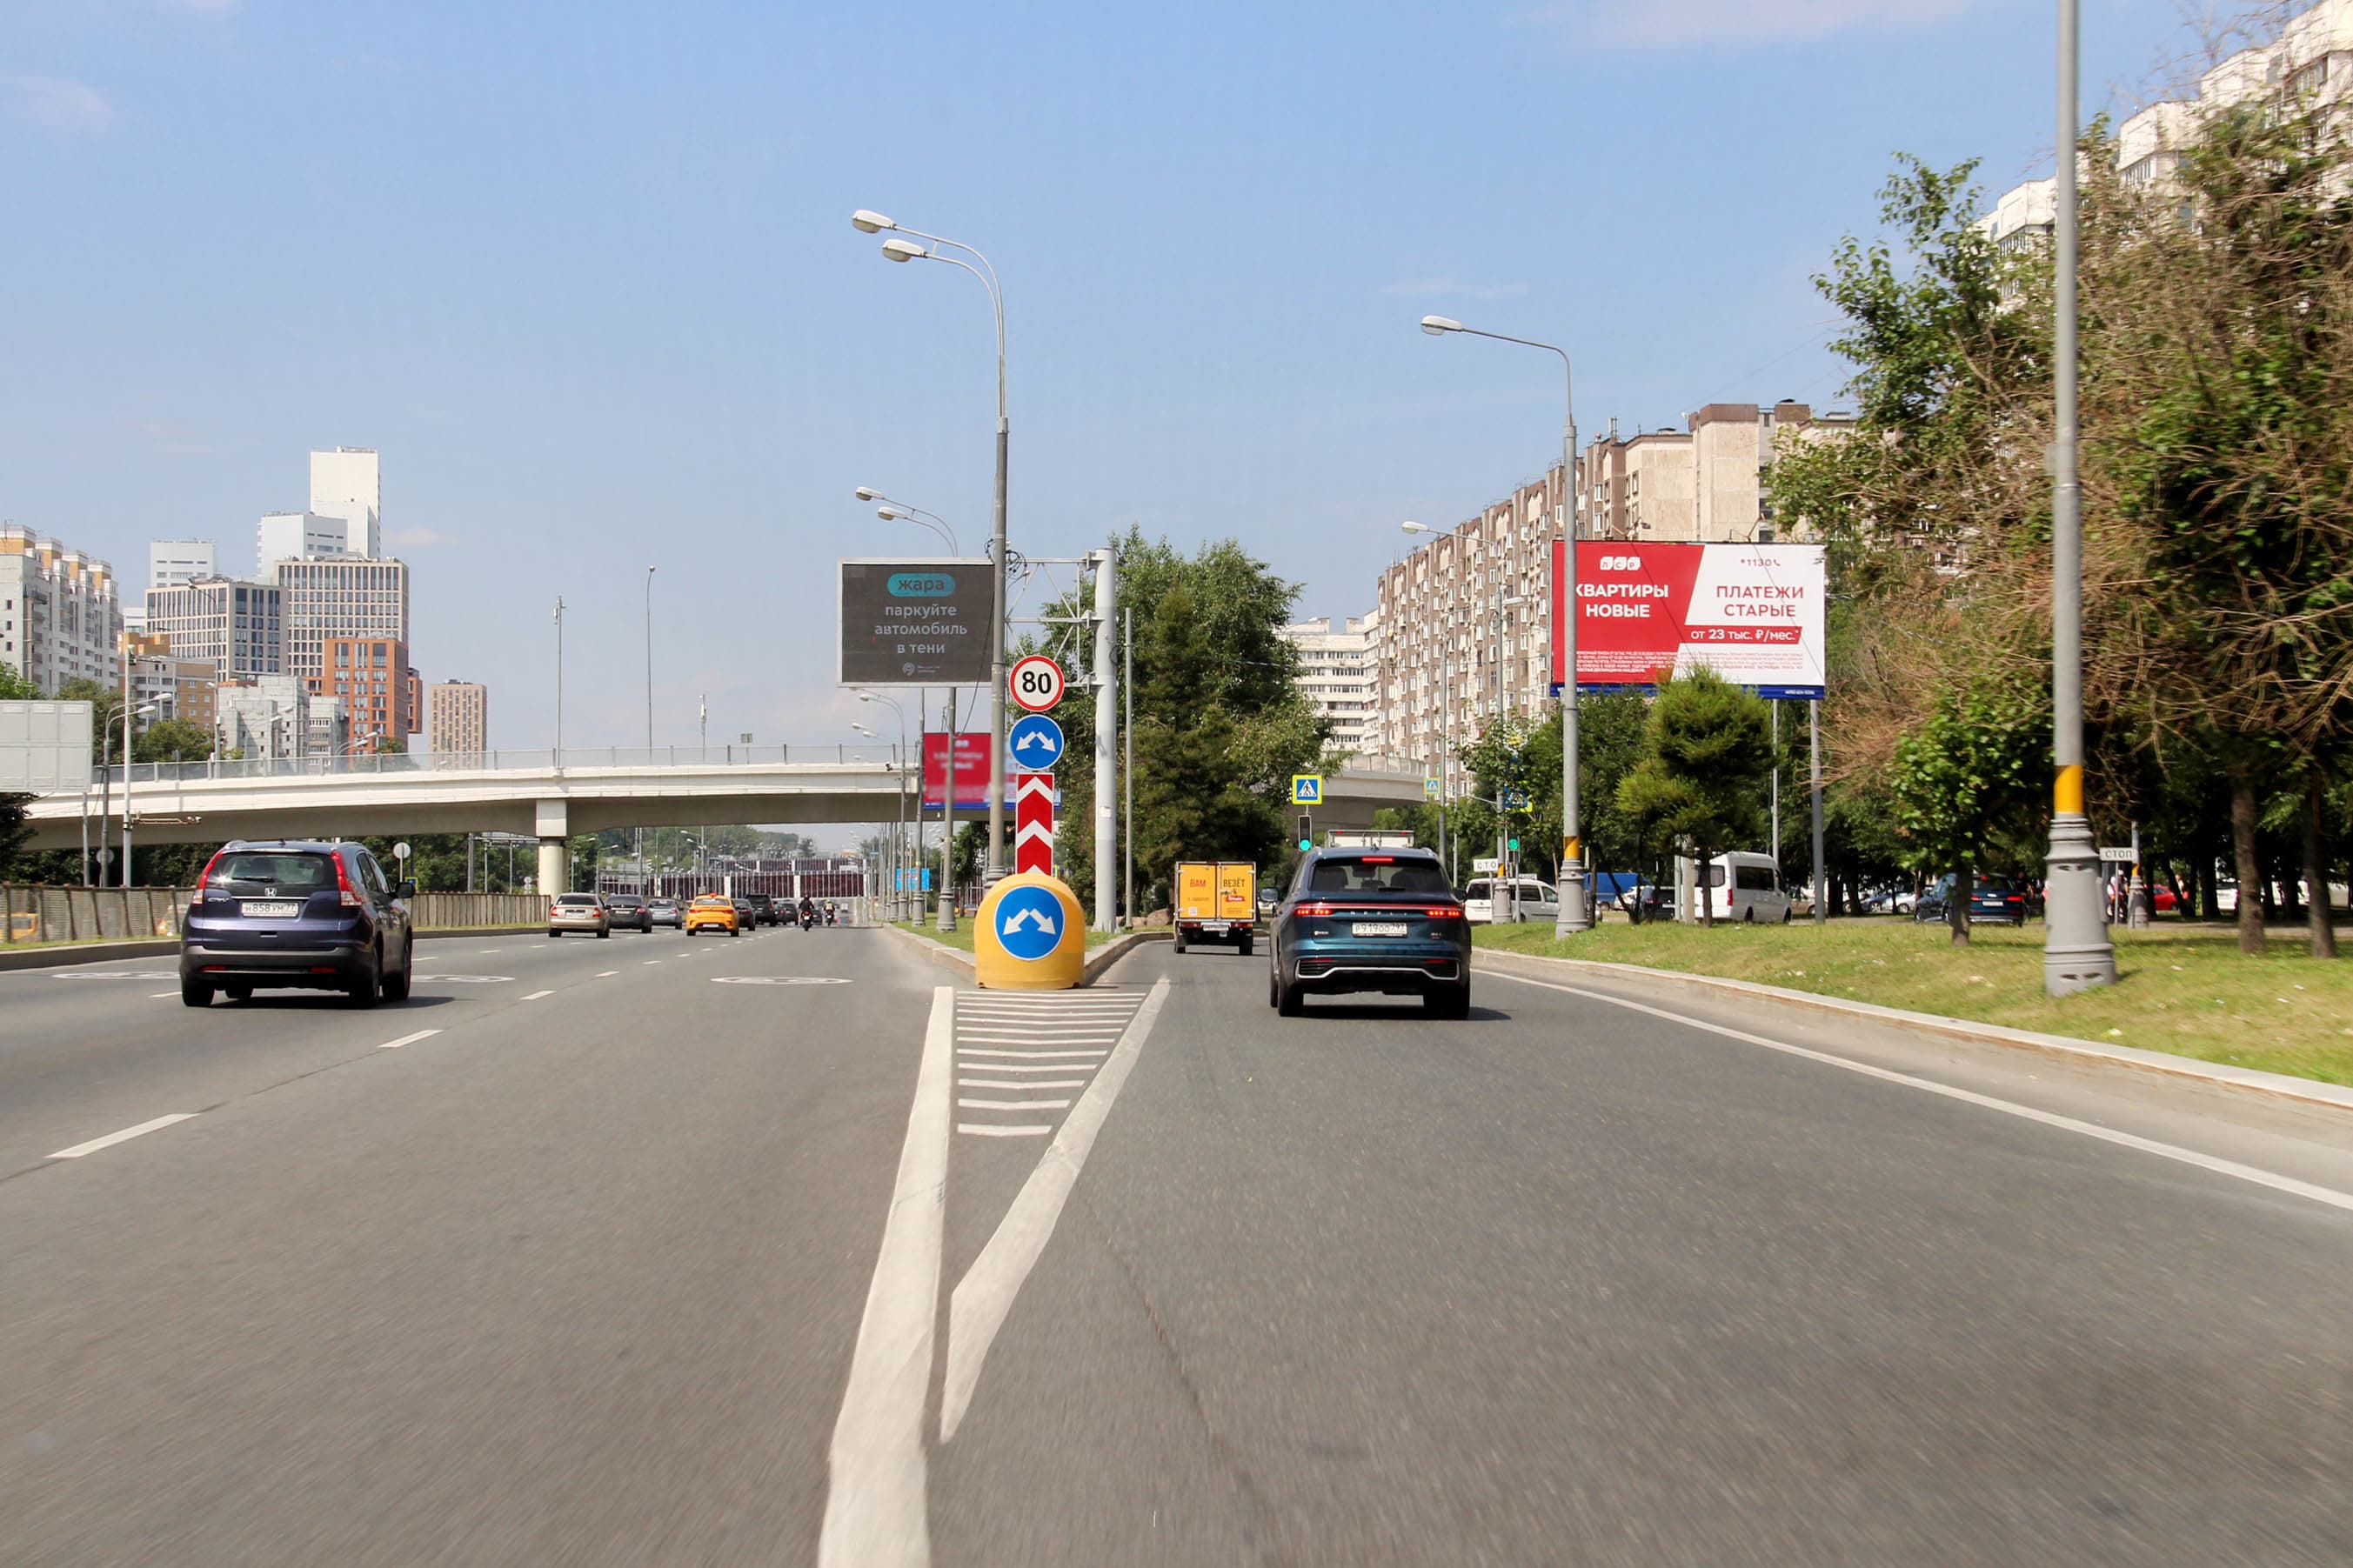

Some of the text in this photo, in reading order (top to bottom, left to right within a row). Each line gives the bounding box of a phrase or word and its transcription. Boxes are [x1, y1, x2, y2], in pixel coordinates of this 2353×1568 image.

[898, 579, 945, 592] жара
[1575, 584, 1668, 597] КВАРТИРЫ
[1716, 585, 1804, 598] ПЛАТЕЖИ
[885, 604, 957, 618] паркуйте
[1586, 604, 1650, 617] НОВЫЕ
[1724, 604, 1796, 617] СТАРЫЕ
[874, 622, 968, 635] автомобиль
[1690, 631, 1706, 639] от
[1708, 629, 1725, 639] 23
[1727, 631, 1754, 640] тыс.
[897, 644, 946, 654] в тени
[1022, 671, 1052, 694] 80
[1477, 861, 1497, 870] СТО
[1189, 878, 1207, 887] ВАМ
